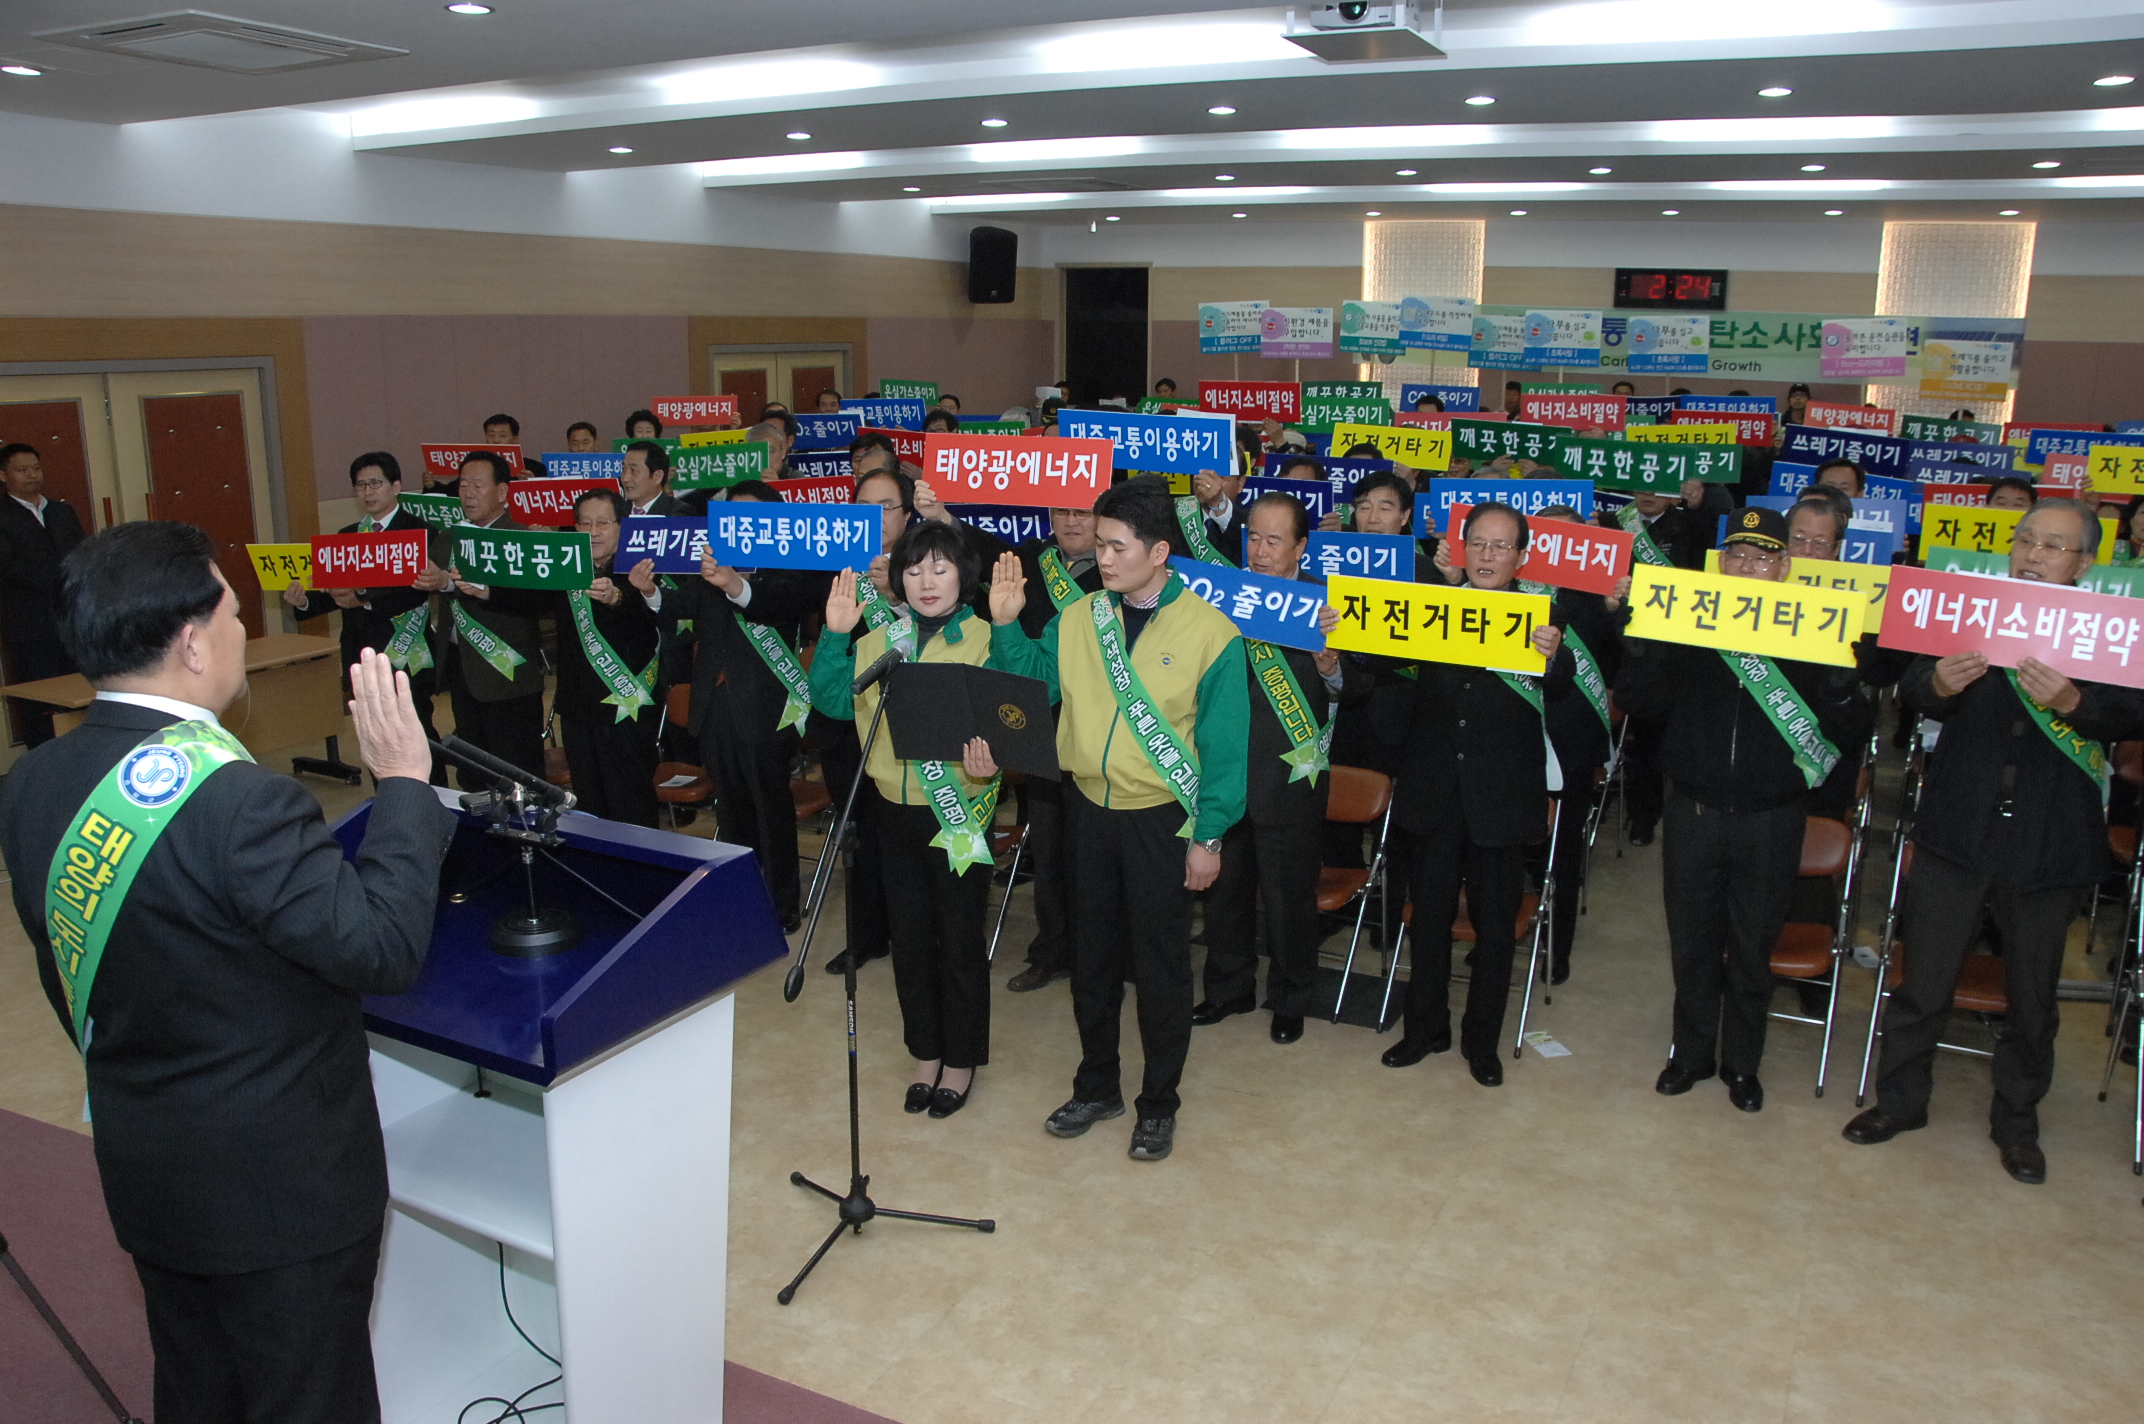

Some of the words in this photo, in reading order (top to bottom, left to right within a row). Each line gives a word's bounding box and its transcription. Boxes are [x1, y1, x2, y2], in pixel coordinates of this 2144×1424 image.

[1648, 274, 1712, 299] 2:24
[1711, 358, 1762, 373] Growth
[657, 401, 732, 419] 태양광에너지
[1204, 389, 1295, 414] 에너지소비절약
[1527, 401, 1620, 424] 에너지소비절약
[1811, 407, 1890, 427] 태양광에너지
[813, 420, 856, 438] 줄이기
[675, 450, 763, 482] 온실가스줄이기
[1562, 446, 1687, 484] 깨끗한공기
[1791, 434, 1901, 466] 쓰레기줄이기
[935, 447, 1099, 491] 태양광에너지
[718, 515, 870, 558] 대중교통이용하기
[318, 541, 419, 575] 에너지소비절약
[459, 538, 583, 579] 깨끗한공기
[1317, 544, 1397, 576] 줄이기
[1231, 583, 1325, 629] 줄이기
[1341, 594, 1534, 650] 자전거타기
[1645, 583, 1849, 644] 자전거타기
[1901, 587, 2141, 667] 에너지소비절약
[1101, 628, 1131, 692] 녹색성장
[1126, 698, 1158, 738] 푸른
[1147, 732, 1183, 770] 옷을
[1261, 664, 1315, 745] 증평입니다
[1763, 686, 1800, 722] 푸른
[931, 783, 969, 826] 증평
[54, 811, 138, 923] 태양의
